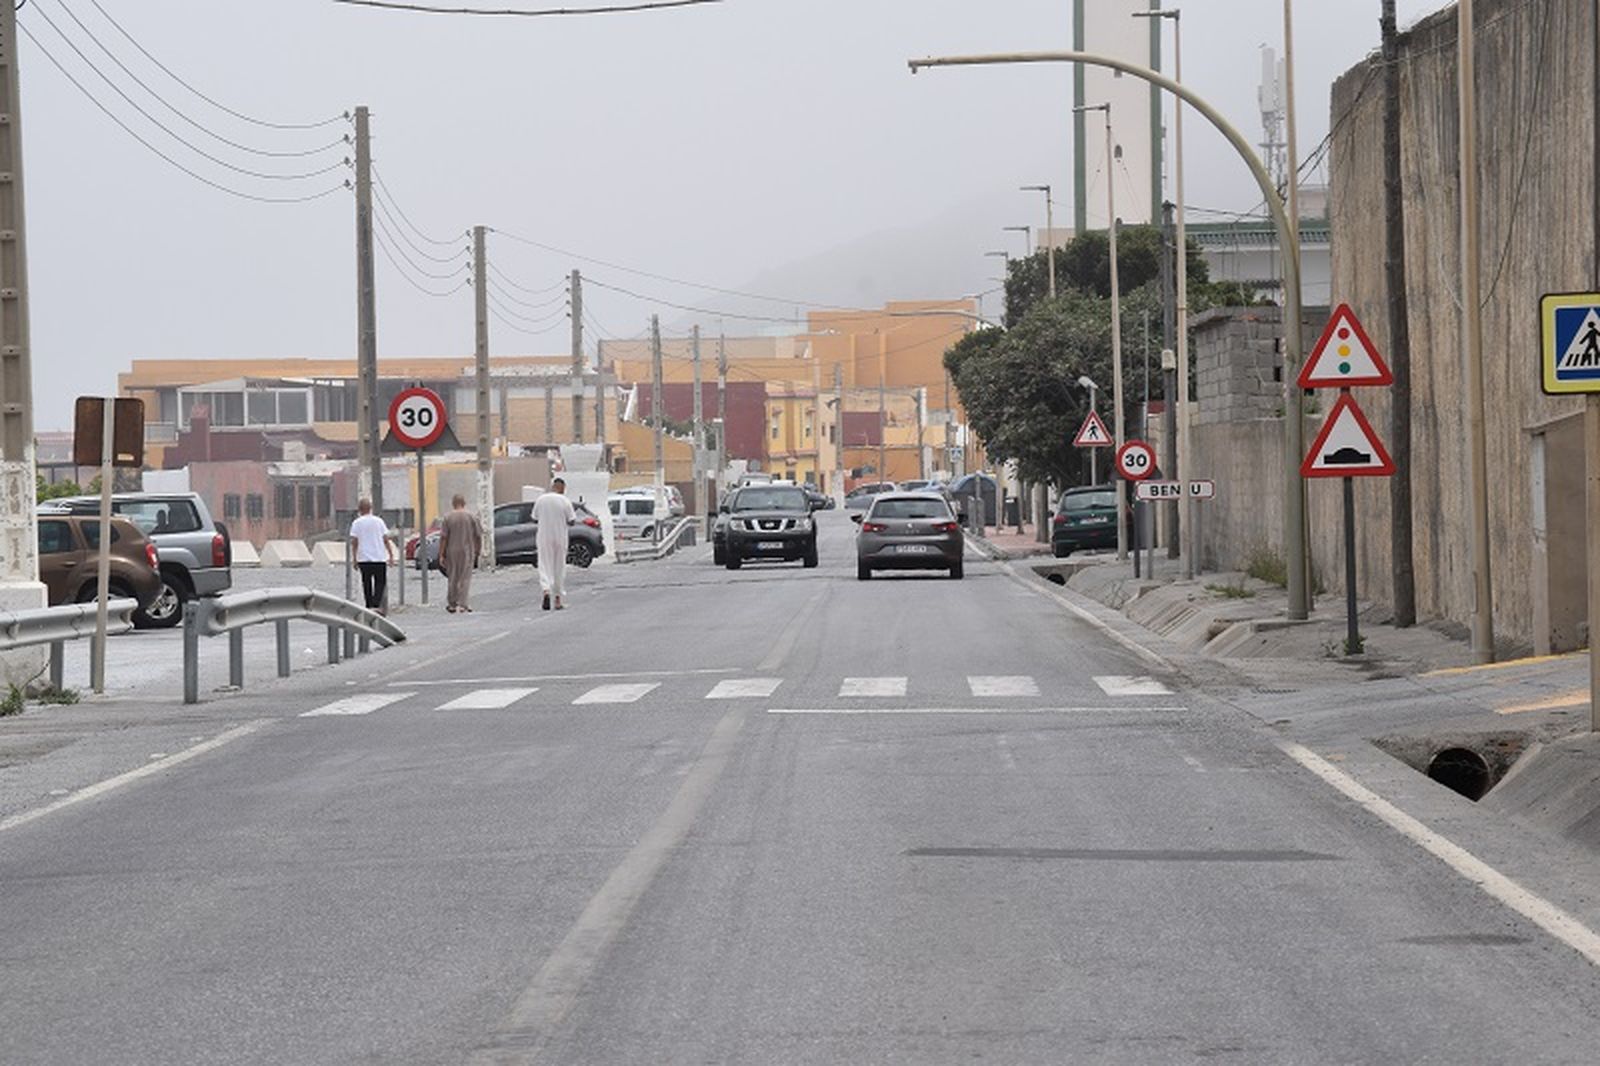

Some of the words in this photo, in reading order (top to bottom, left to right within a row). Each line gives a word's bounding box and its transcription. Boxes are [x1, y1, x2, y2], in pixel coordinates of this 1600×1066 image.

[402, 408, 432, 427] 30
[1125, 454, 1147, 467] 30
[1150, 484, 1201, 496] BENU
